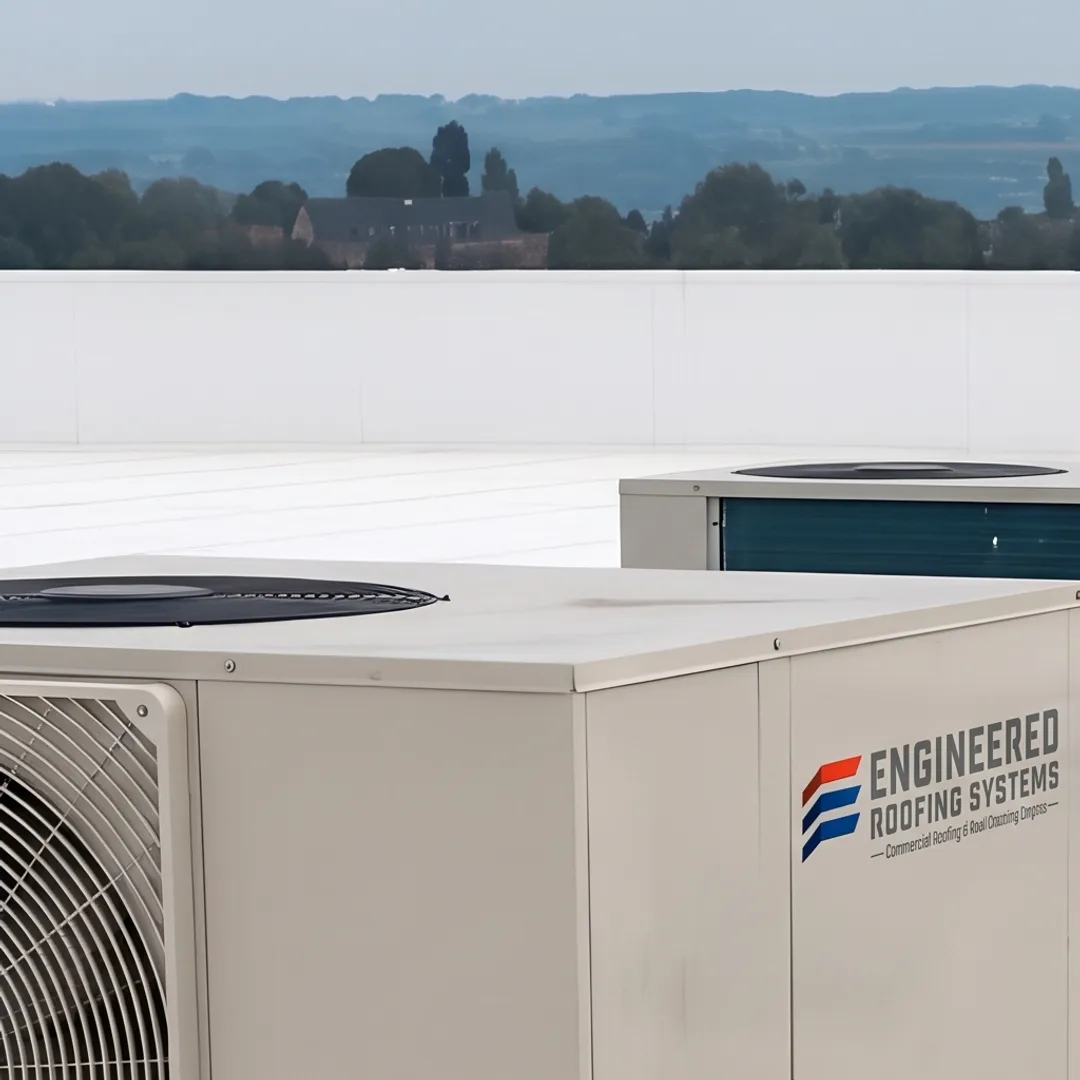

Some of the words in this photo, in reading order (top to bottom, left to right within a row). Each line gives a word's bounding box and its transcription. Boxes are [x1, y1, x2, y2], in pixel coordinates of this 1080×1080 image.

[870, 708, 1059, 801] ENGINEERED
[870, 786, 962, 840] ROOFING
[969, 760, 1059, 812] SYSTEMS
[885, 832, 932, 859] Commercial
